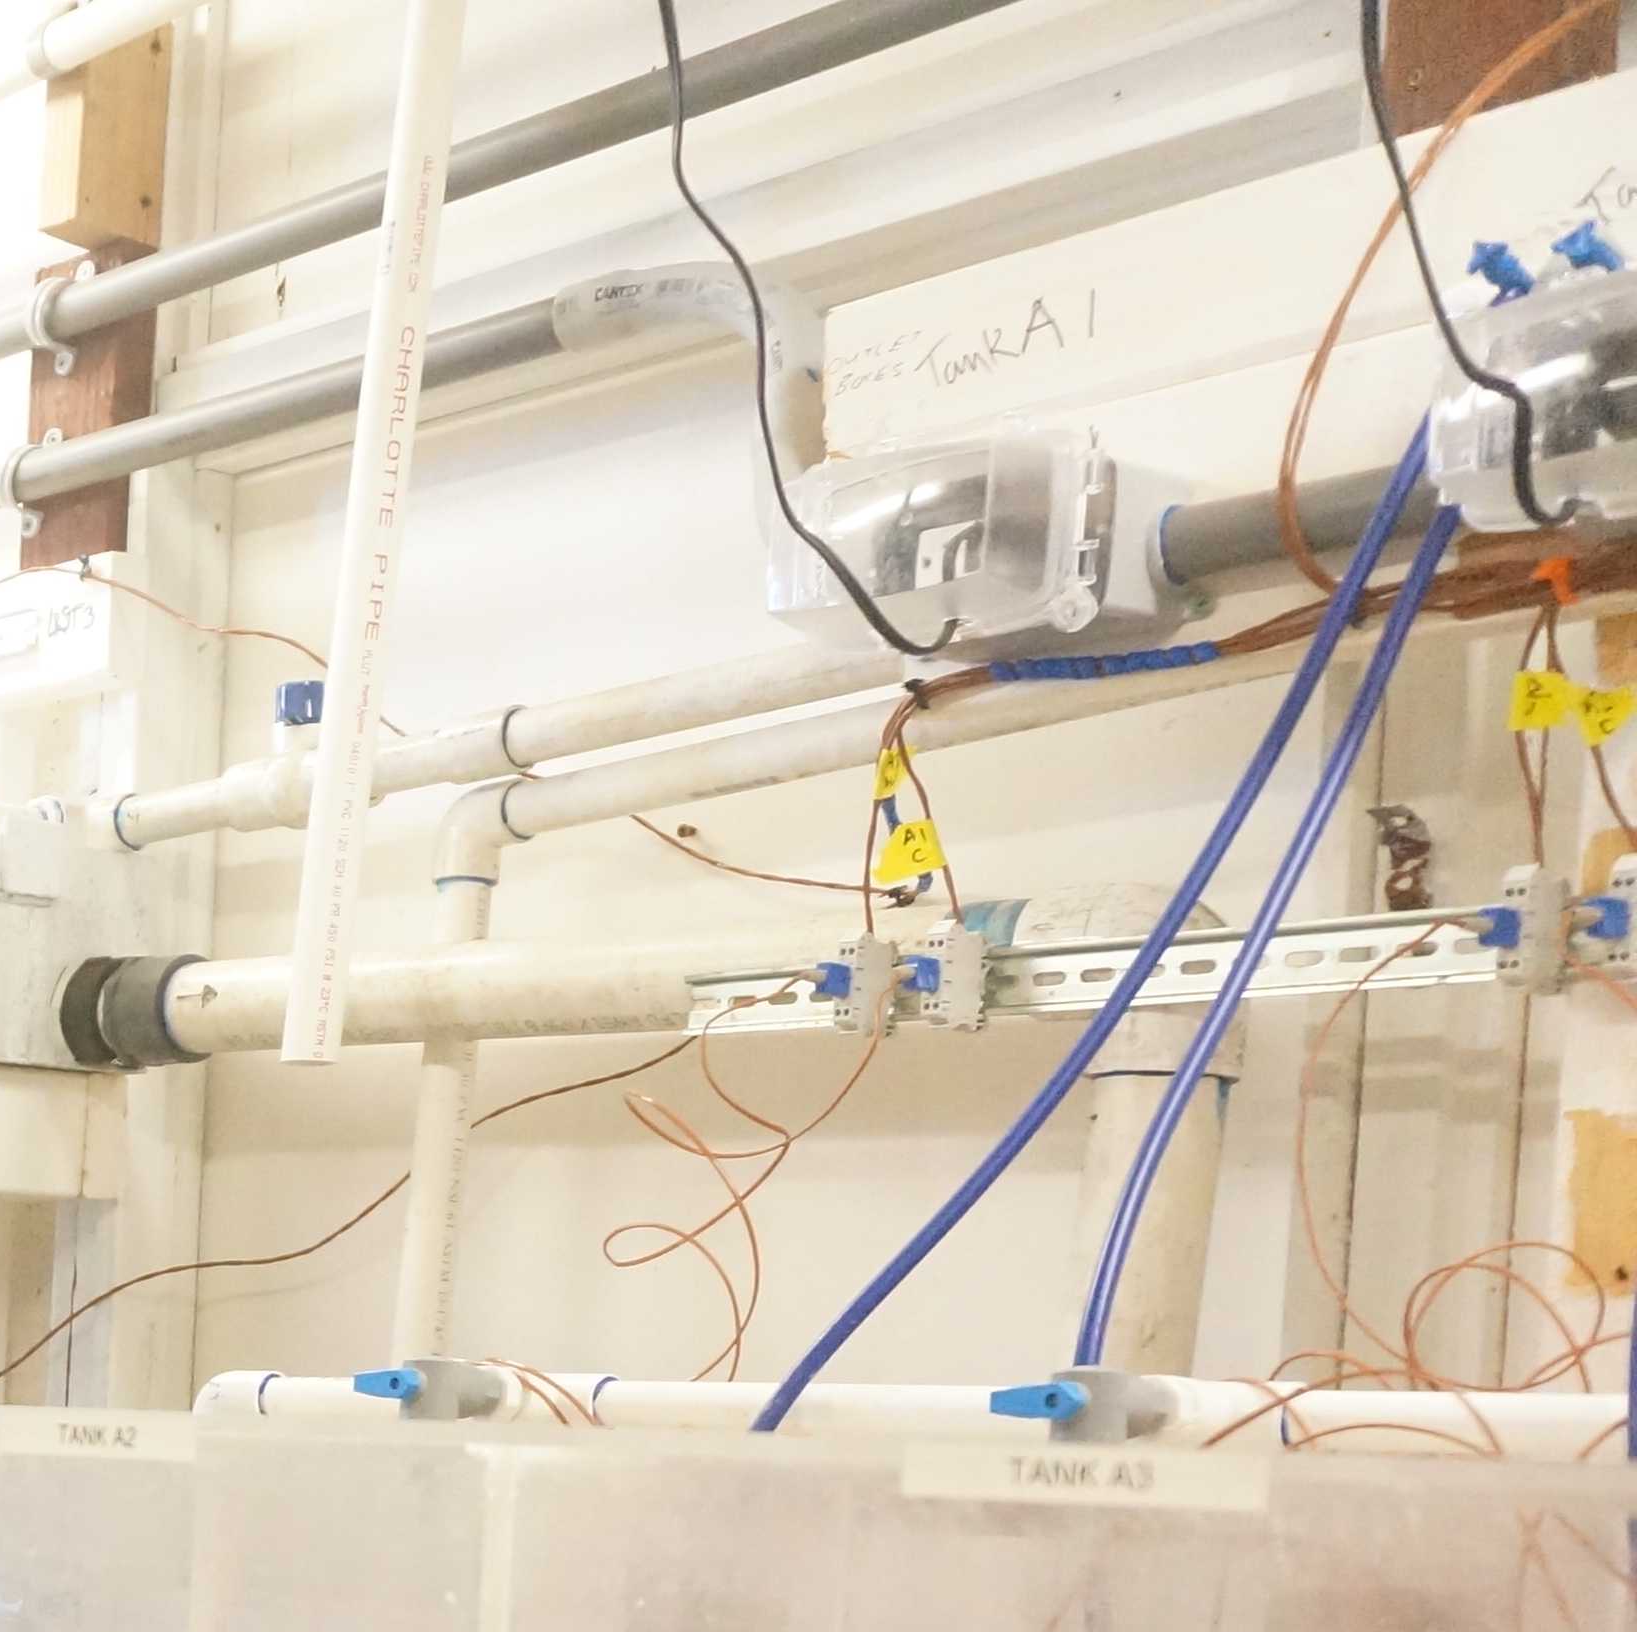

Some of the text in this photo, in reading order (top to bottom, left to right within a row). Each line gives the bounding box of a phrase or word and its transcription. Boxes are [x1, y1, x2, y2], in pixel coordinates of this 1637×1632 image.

[378, 326, 416, 528] CHARLOTTE
[364, 553, 389, 642] PIPE
[58, 1422, 138, 1449] TANK A2
[1008, 1455, 1101, 1489] TANK
